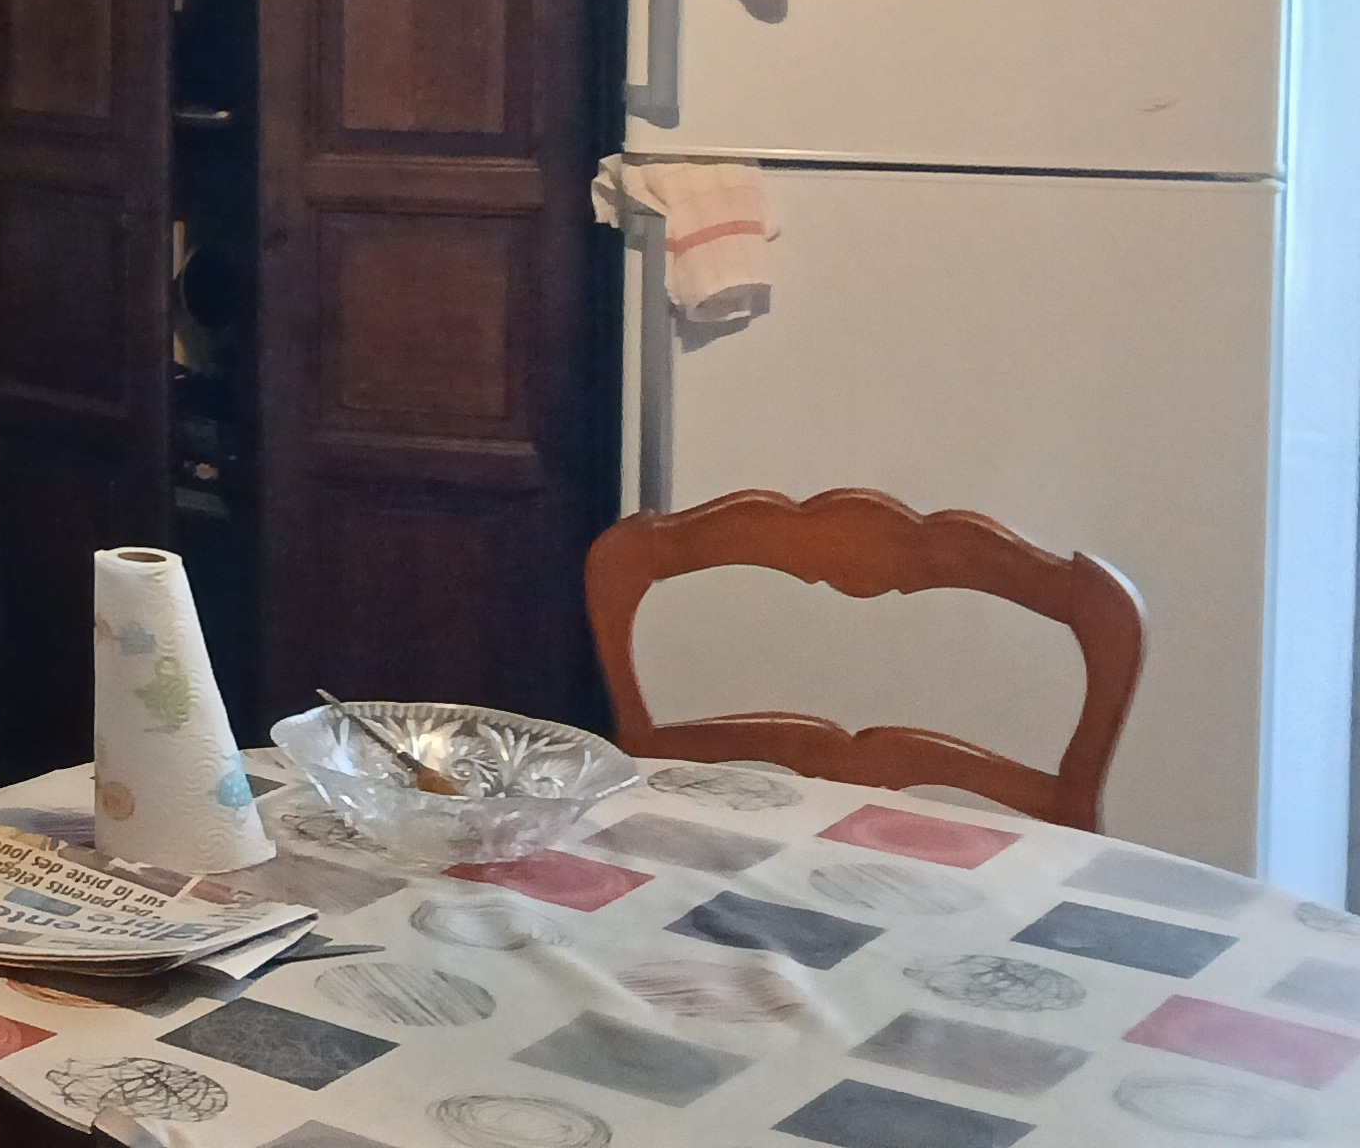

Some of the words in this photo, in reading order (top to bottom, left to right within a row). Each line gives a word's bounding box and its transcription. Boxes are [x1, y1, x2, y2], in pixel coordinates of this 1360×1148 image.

[31, 855, 63, 874] des
[66, 868, 113, 890] piste
[45, 880, 118, 909] parents
[112, 884, 133, 902] la
[135, 894, 167, 908] sur
